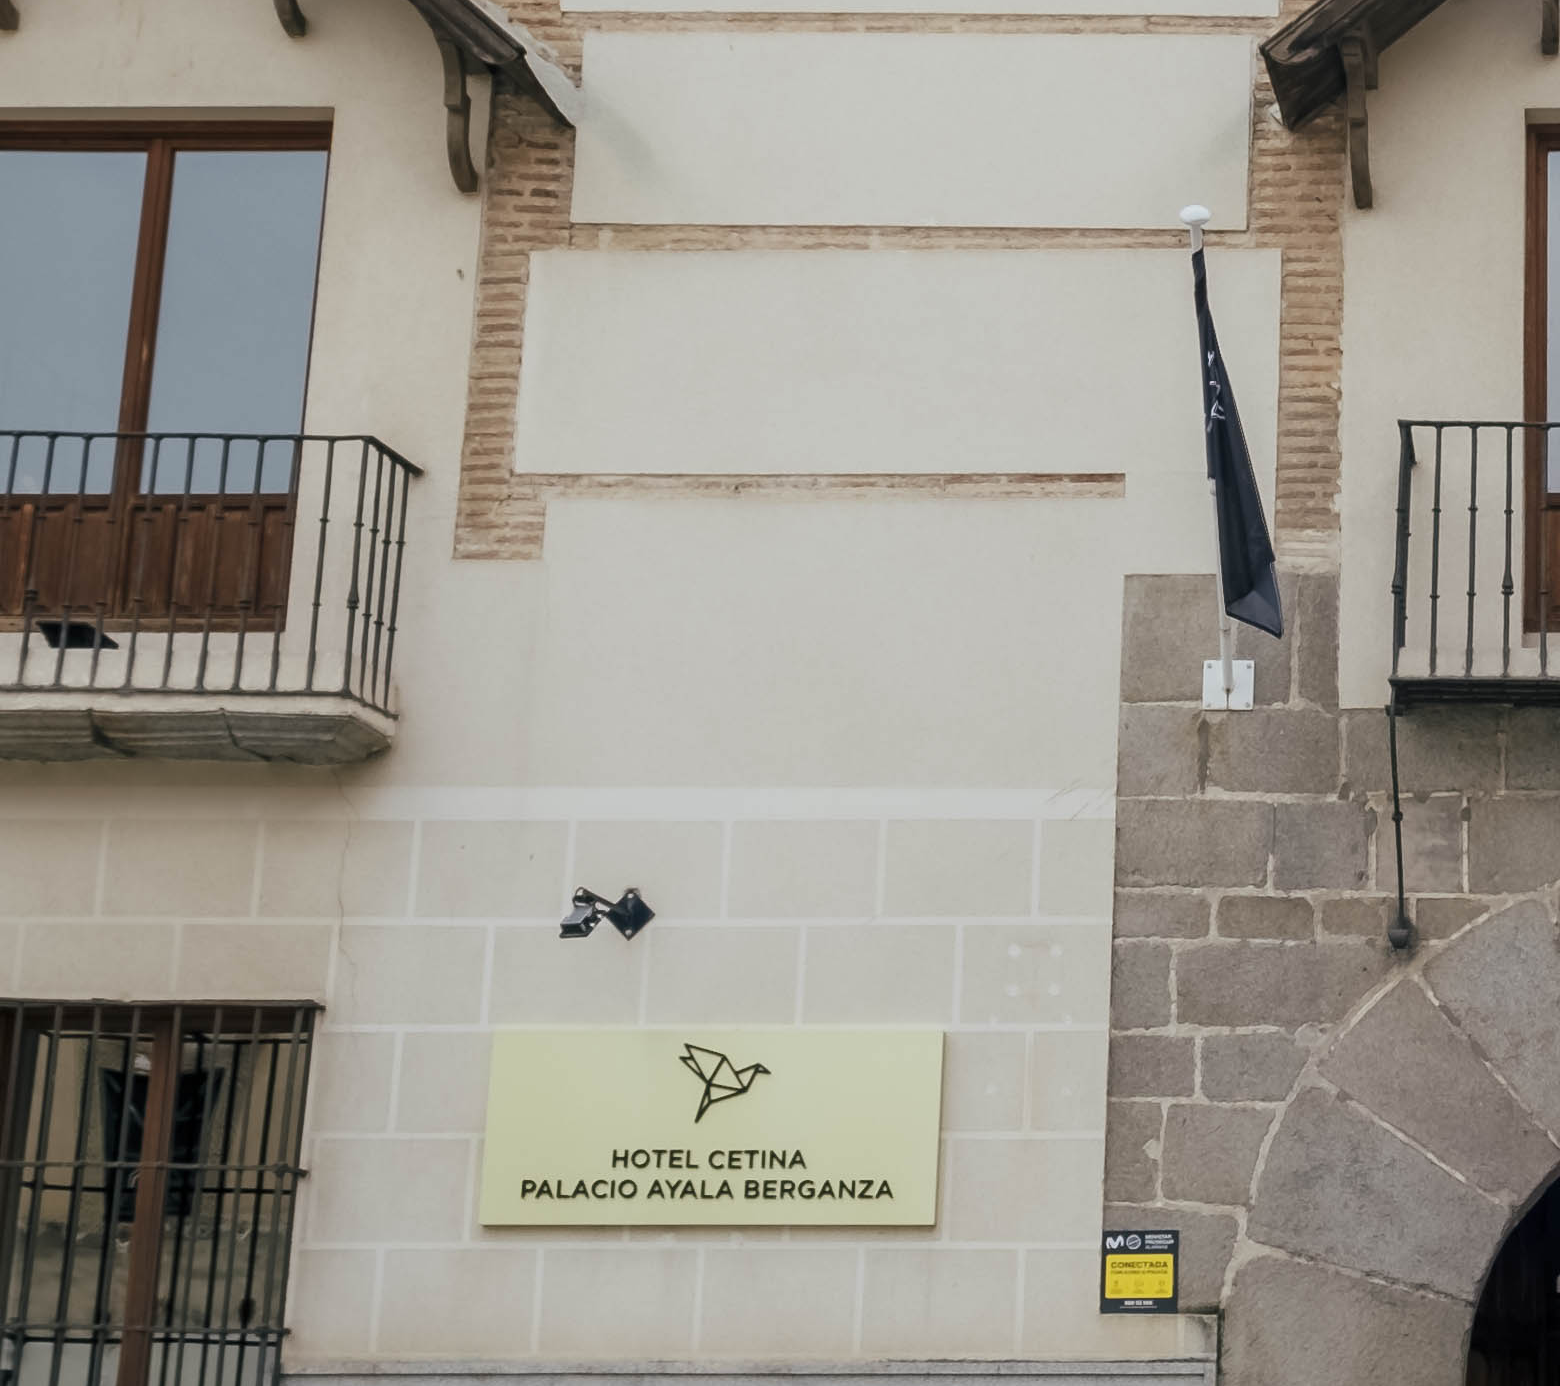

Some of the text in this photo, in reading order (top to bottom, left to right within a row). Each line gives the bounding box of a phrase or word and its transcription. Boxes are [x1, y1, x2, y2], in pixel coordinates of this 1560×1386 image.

[611, 1148, 807, 1170] HOTEL CETINA
[520, 1179, 895, 1200] PALACIO AYALA BERGANZA
[1110, 1261, 1168, 1269] CONECTADA
